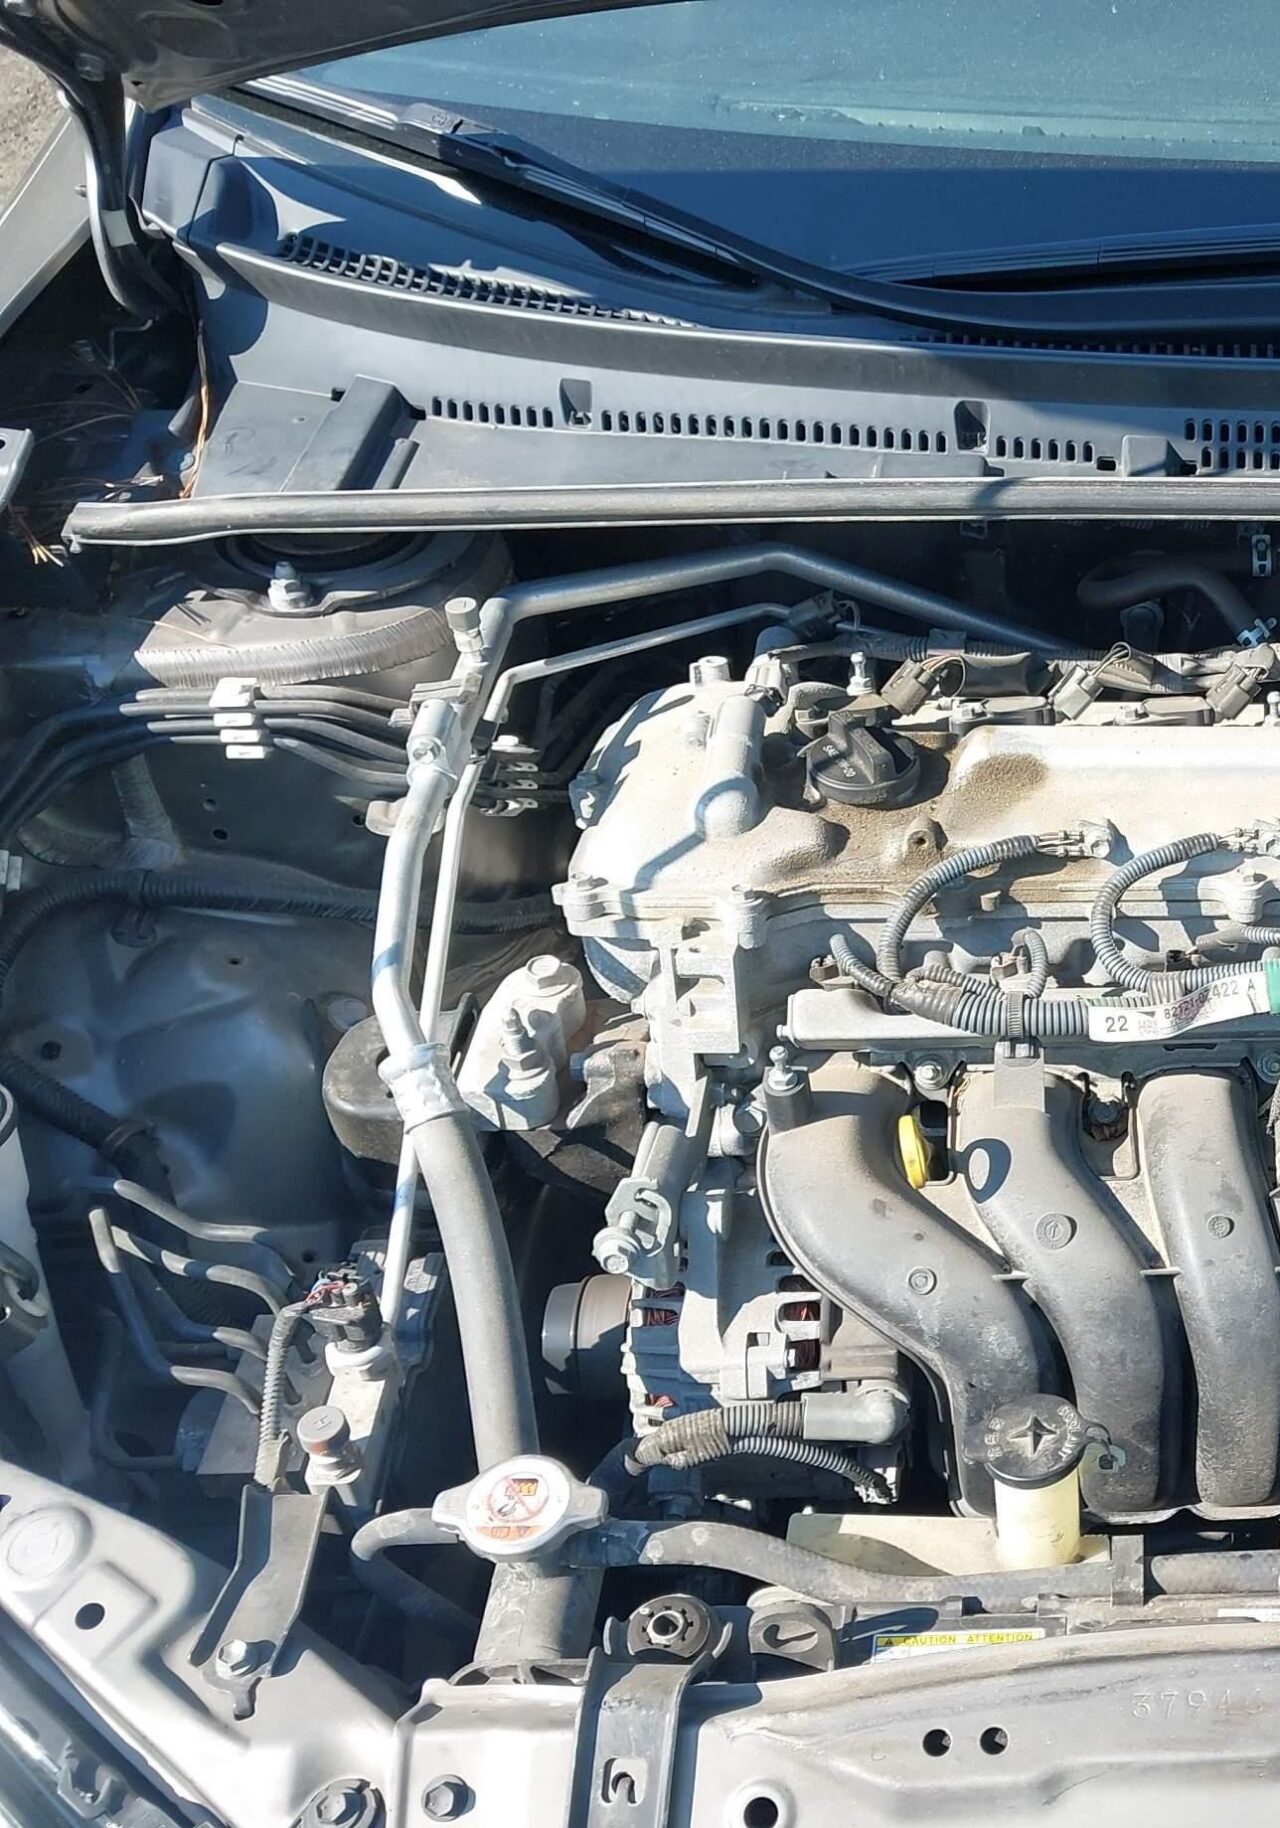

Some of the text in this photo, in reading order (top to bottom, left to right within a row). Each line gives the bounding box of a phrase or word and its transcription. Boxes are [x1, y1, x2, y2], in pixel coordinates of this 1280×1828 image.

[1105, 1015, 1129, 1033] 22
[902, 1633, 1034, 1646] CAUTION ATTENTION
